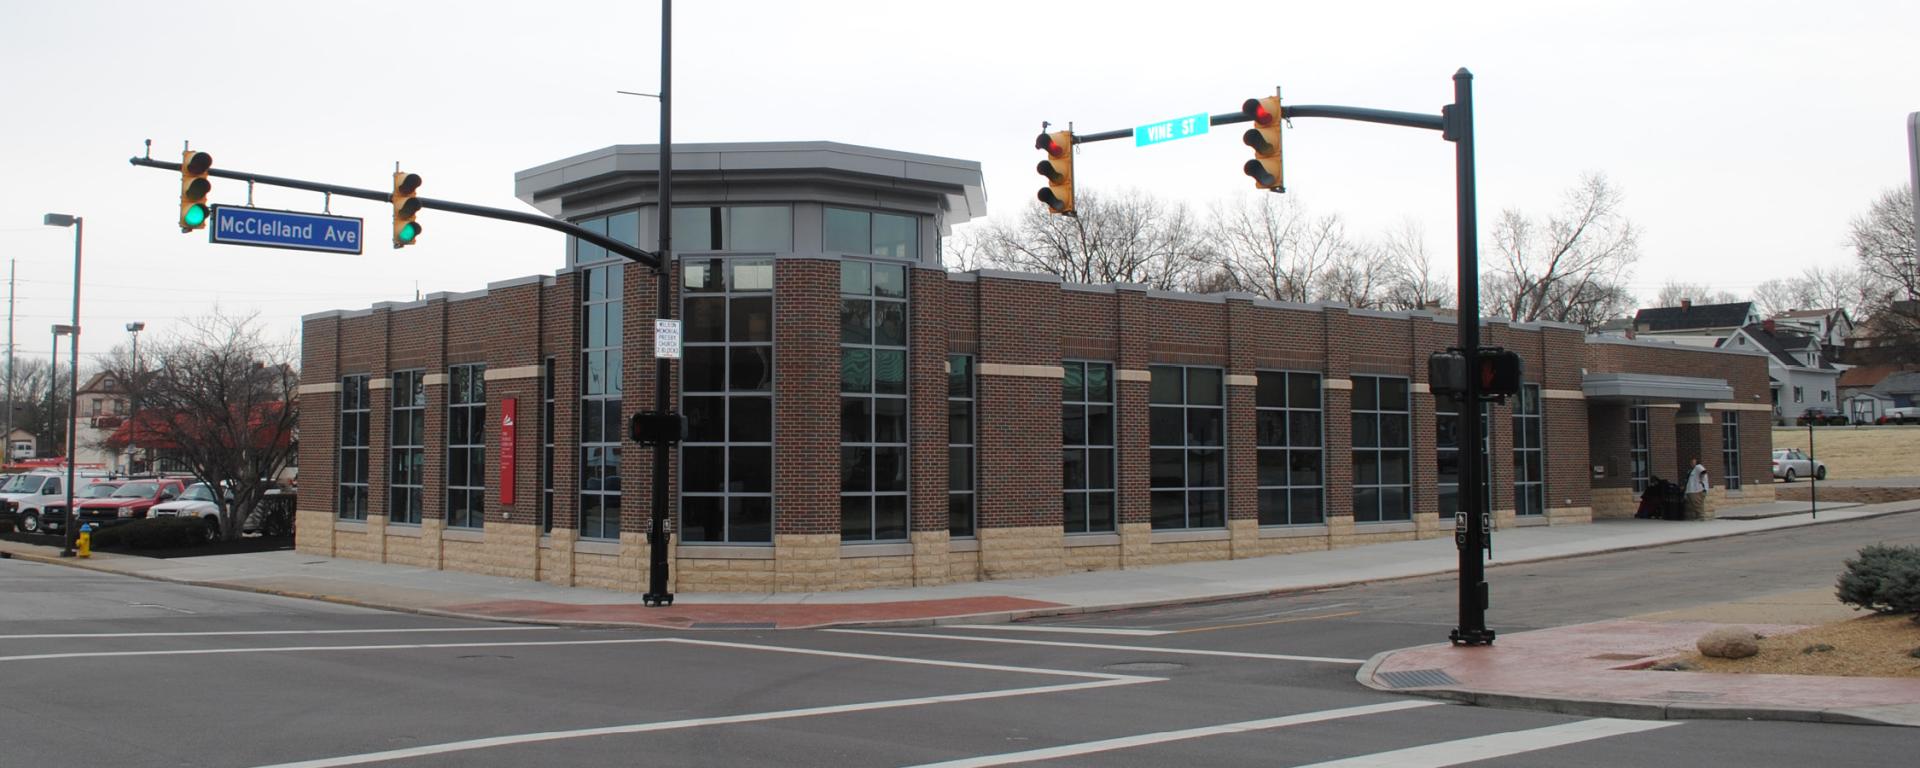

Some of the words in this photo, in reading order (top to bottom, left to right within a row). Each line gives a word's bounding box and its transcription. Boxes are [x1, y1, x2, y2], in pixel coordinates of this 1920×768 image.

[1147, 122, 1173, 142] VINE
[1183, 119, 1195, 135] ST
[220, 215, 312, 239] McClelland
[324, 225, 356, 243] Ave
